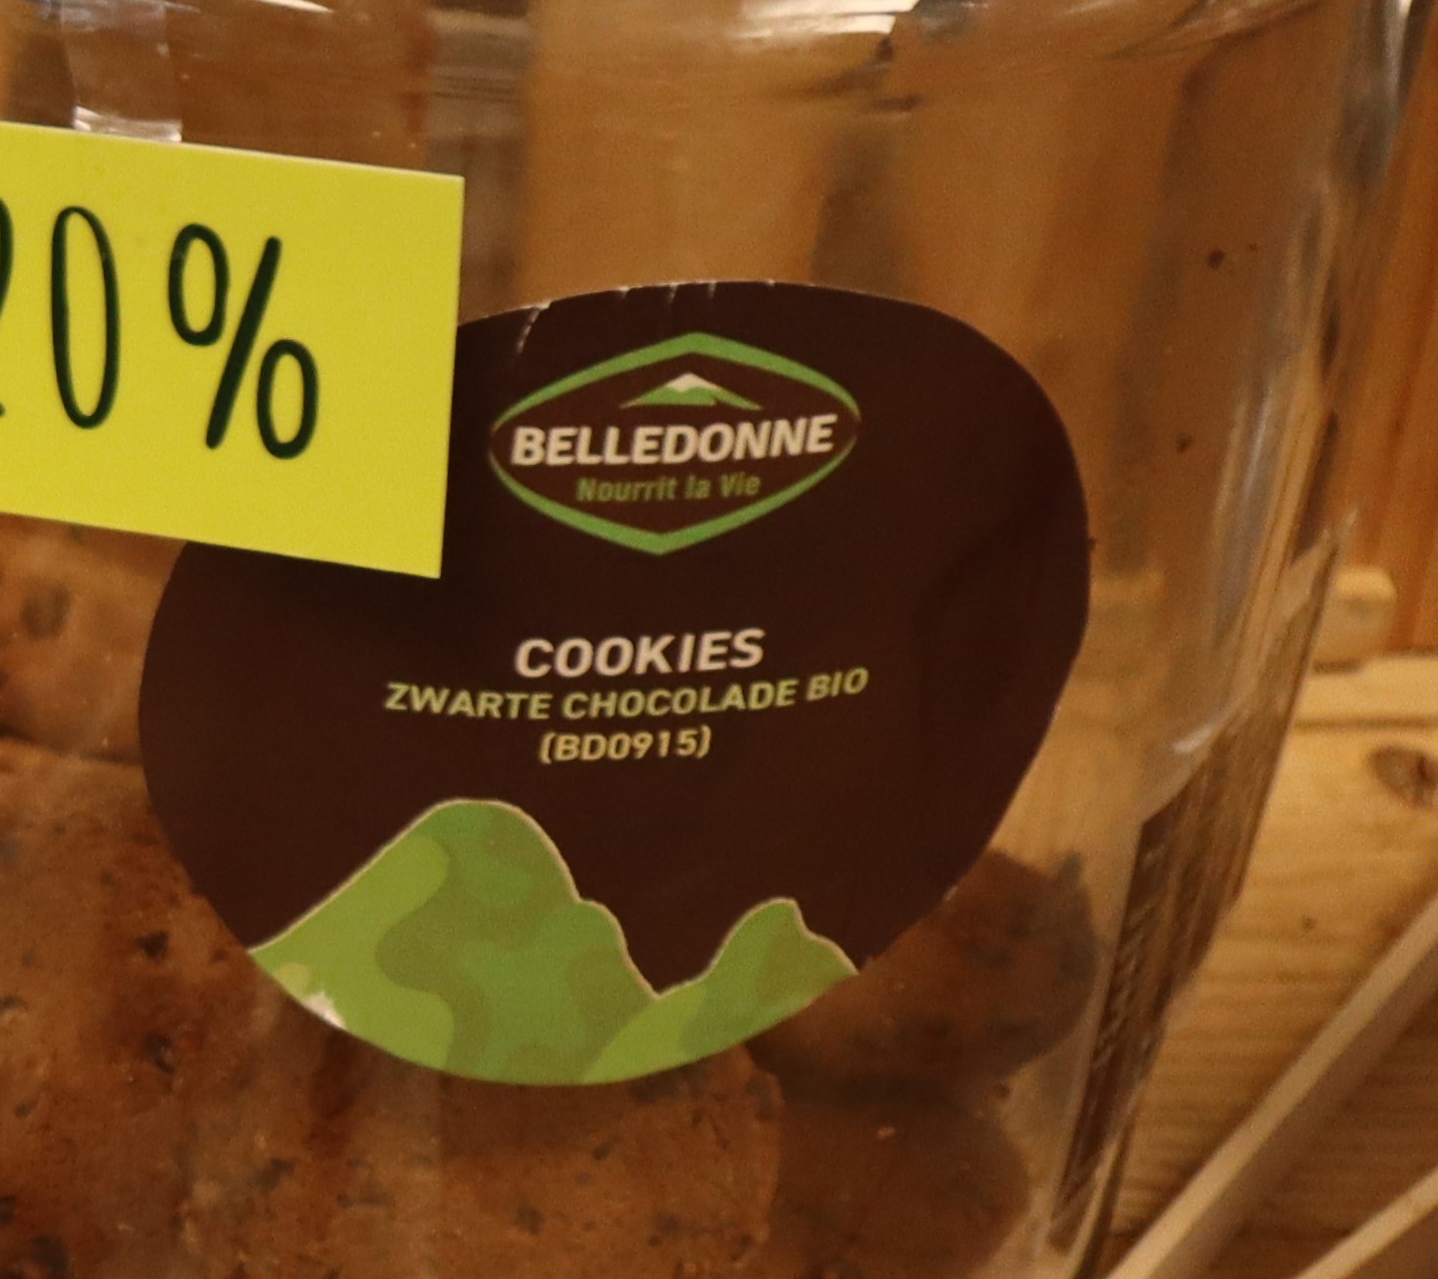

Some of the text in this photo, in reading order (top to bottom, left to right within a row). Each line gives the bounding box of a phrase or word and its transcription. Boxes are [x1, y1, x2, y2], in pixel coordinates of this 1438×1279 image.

[509, 413, 839, 467] BELLEDONNE
[574, 472, 762, 503] Nourrit la Vie
[513, 626, 766, 679] COOKIES
[385, 666, 871, 721] ZWARTE CHOCOLADE BIO
[538, 724, 713, 764] (BD0915)
